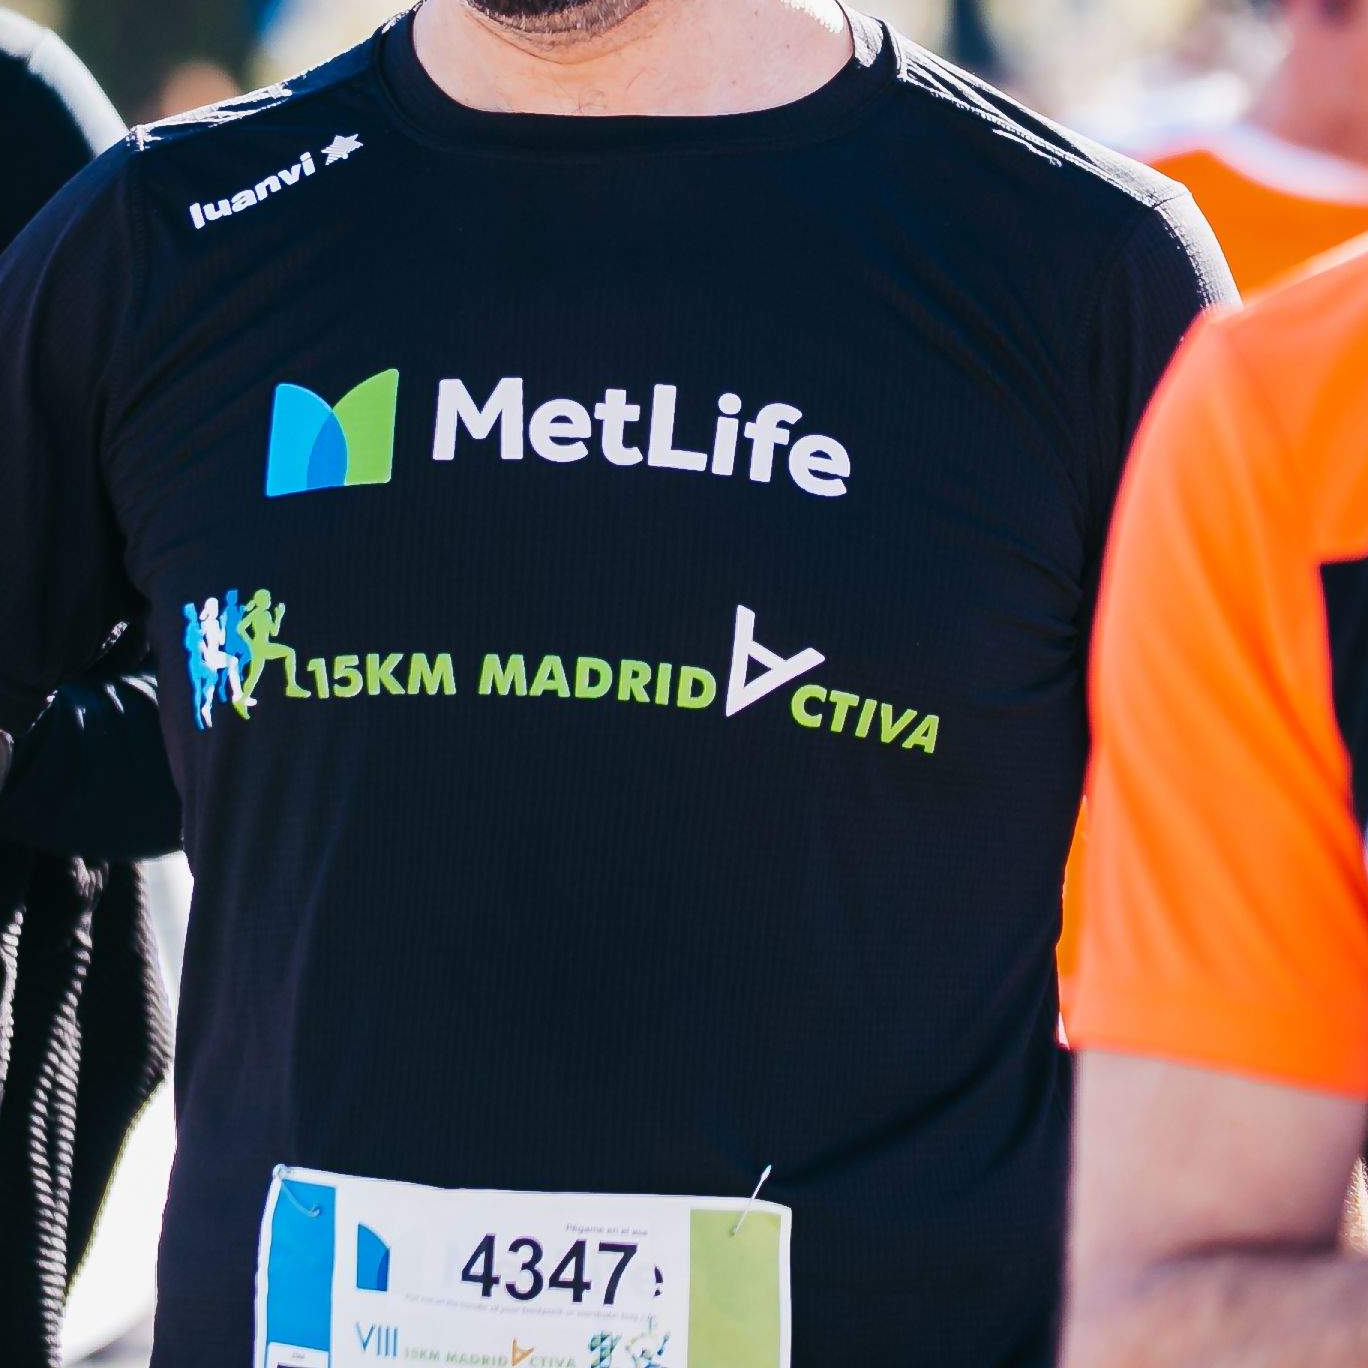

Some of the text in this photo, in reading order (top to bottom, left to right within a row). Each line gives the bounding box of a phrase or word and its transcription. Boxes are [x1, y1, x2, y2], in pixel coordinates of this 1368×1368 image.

[189, 151, 316, 230] luanvi
[432, 376, 852, 498] MetLife
[306, 653, 458, 701] 15KM
[479, 652, 718, 711] MADRID
[460, 1232, 638, 1306] 4347
[355, 1321, 399, 1358] VIII
[446, 1350, 508, 1368] MADRID
